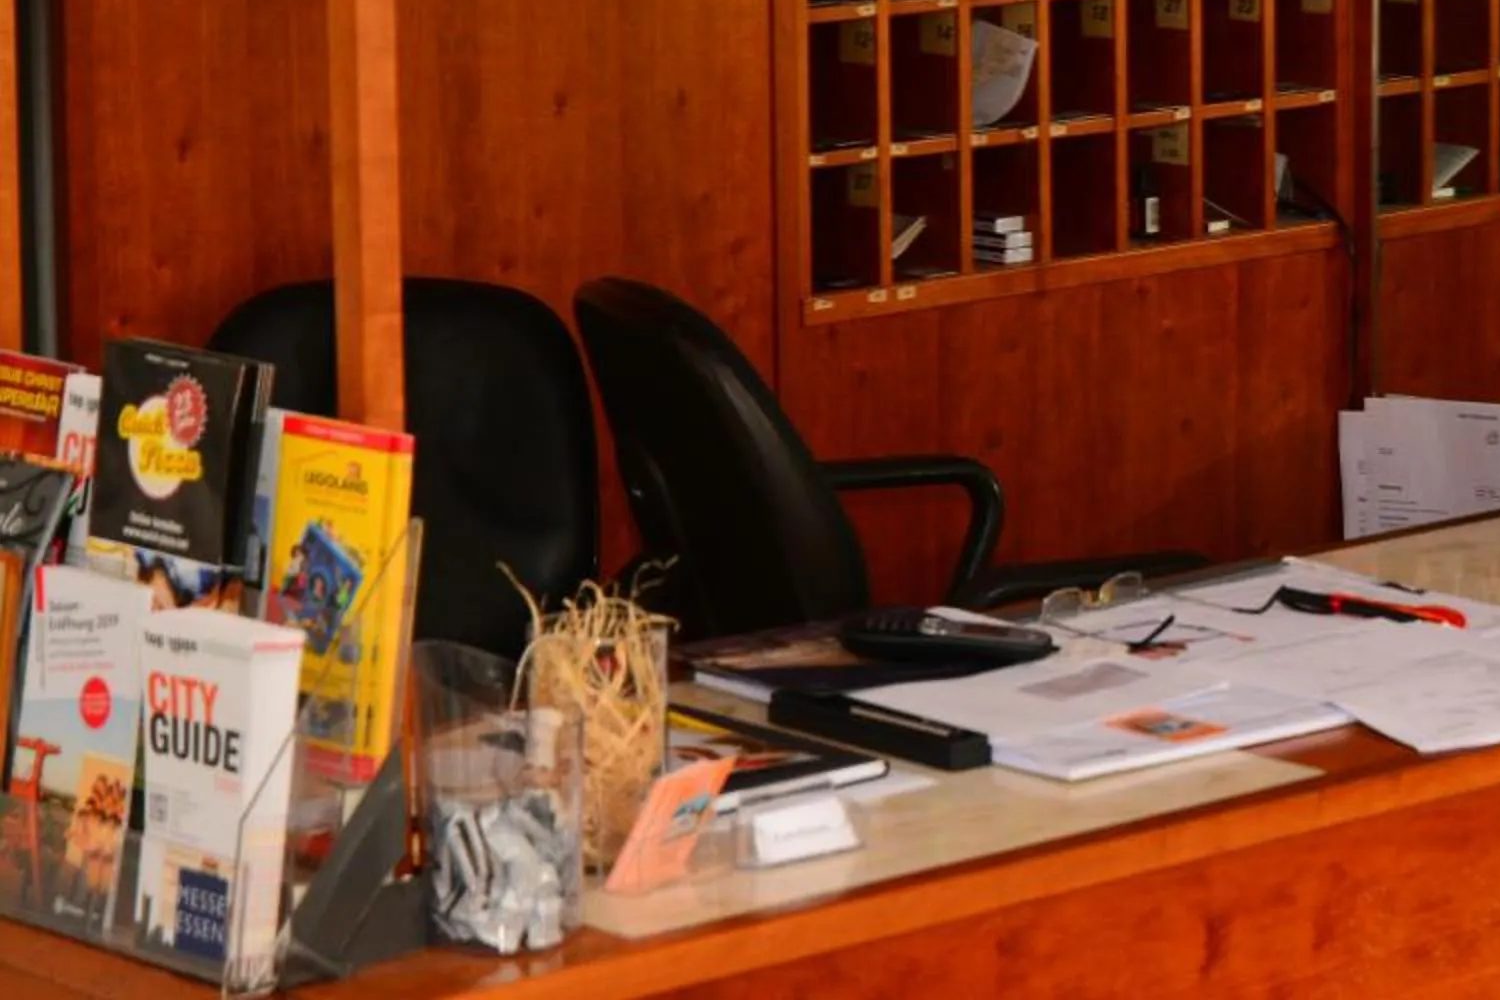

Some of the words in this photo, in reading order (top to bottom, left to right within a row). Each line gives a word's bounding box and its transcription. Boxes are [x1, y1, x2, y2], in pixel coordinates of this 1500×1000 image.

[305, 471, 368, 495] LEGOLAND
[148, 670, 219, 724] CITY
[150, 711, 240, 773] GUIDE
